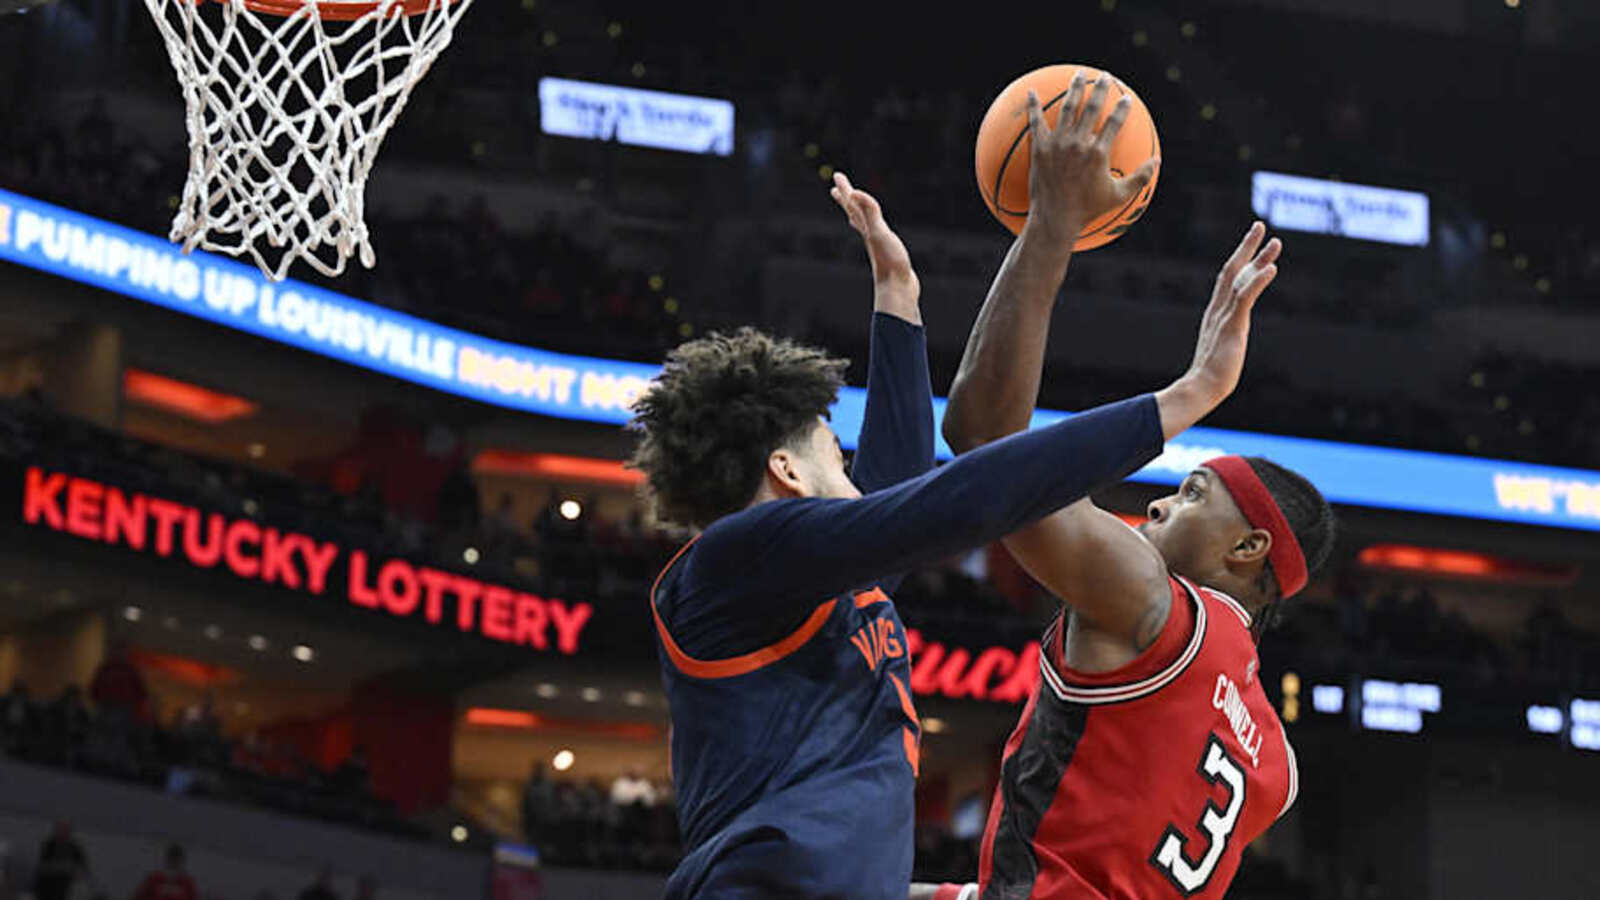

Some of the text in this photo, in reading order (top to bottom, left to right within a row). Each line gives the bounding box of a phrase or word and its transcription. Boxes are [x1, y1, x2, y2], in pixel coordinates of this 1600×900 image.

[16, 209, 200, 300] PUMPING
[204, 266, 256, 315] UP
[258, 283, 455, 379] LOUISVILLE
[458, 346, 576, 403] RIGHT
[581, 371, 652, 409] NO
[23, 465, 593, 655] KENTUCKY LOTTERY
[1151, 733, 1246, 897] 3
